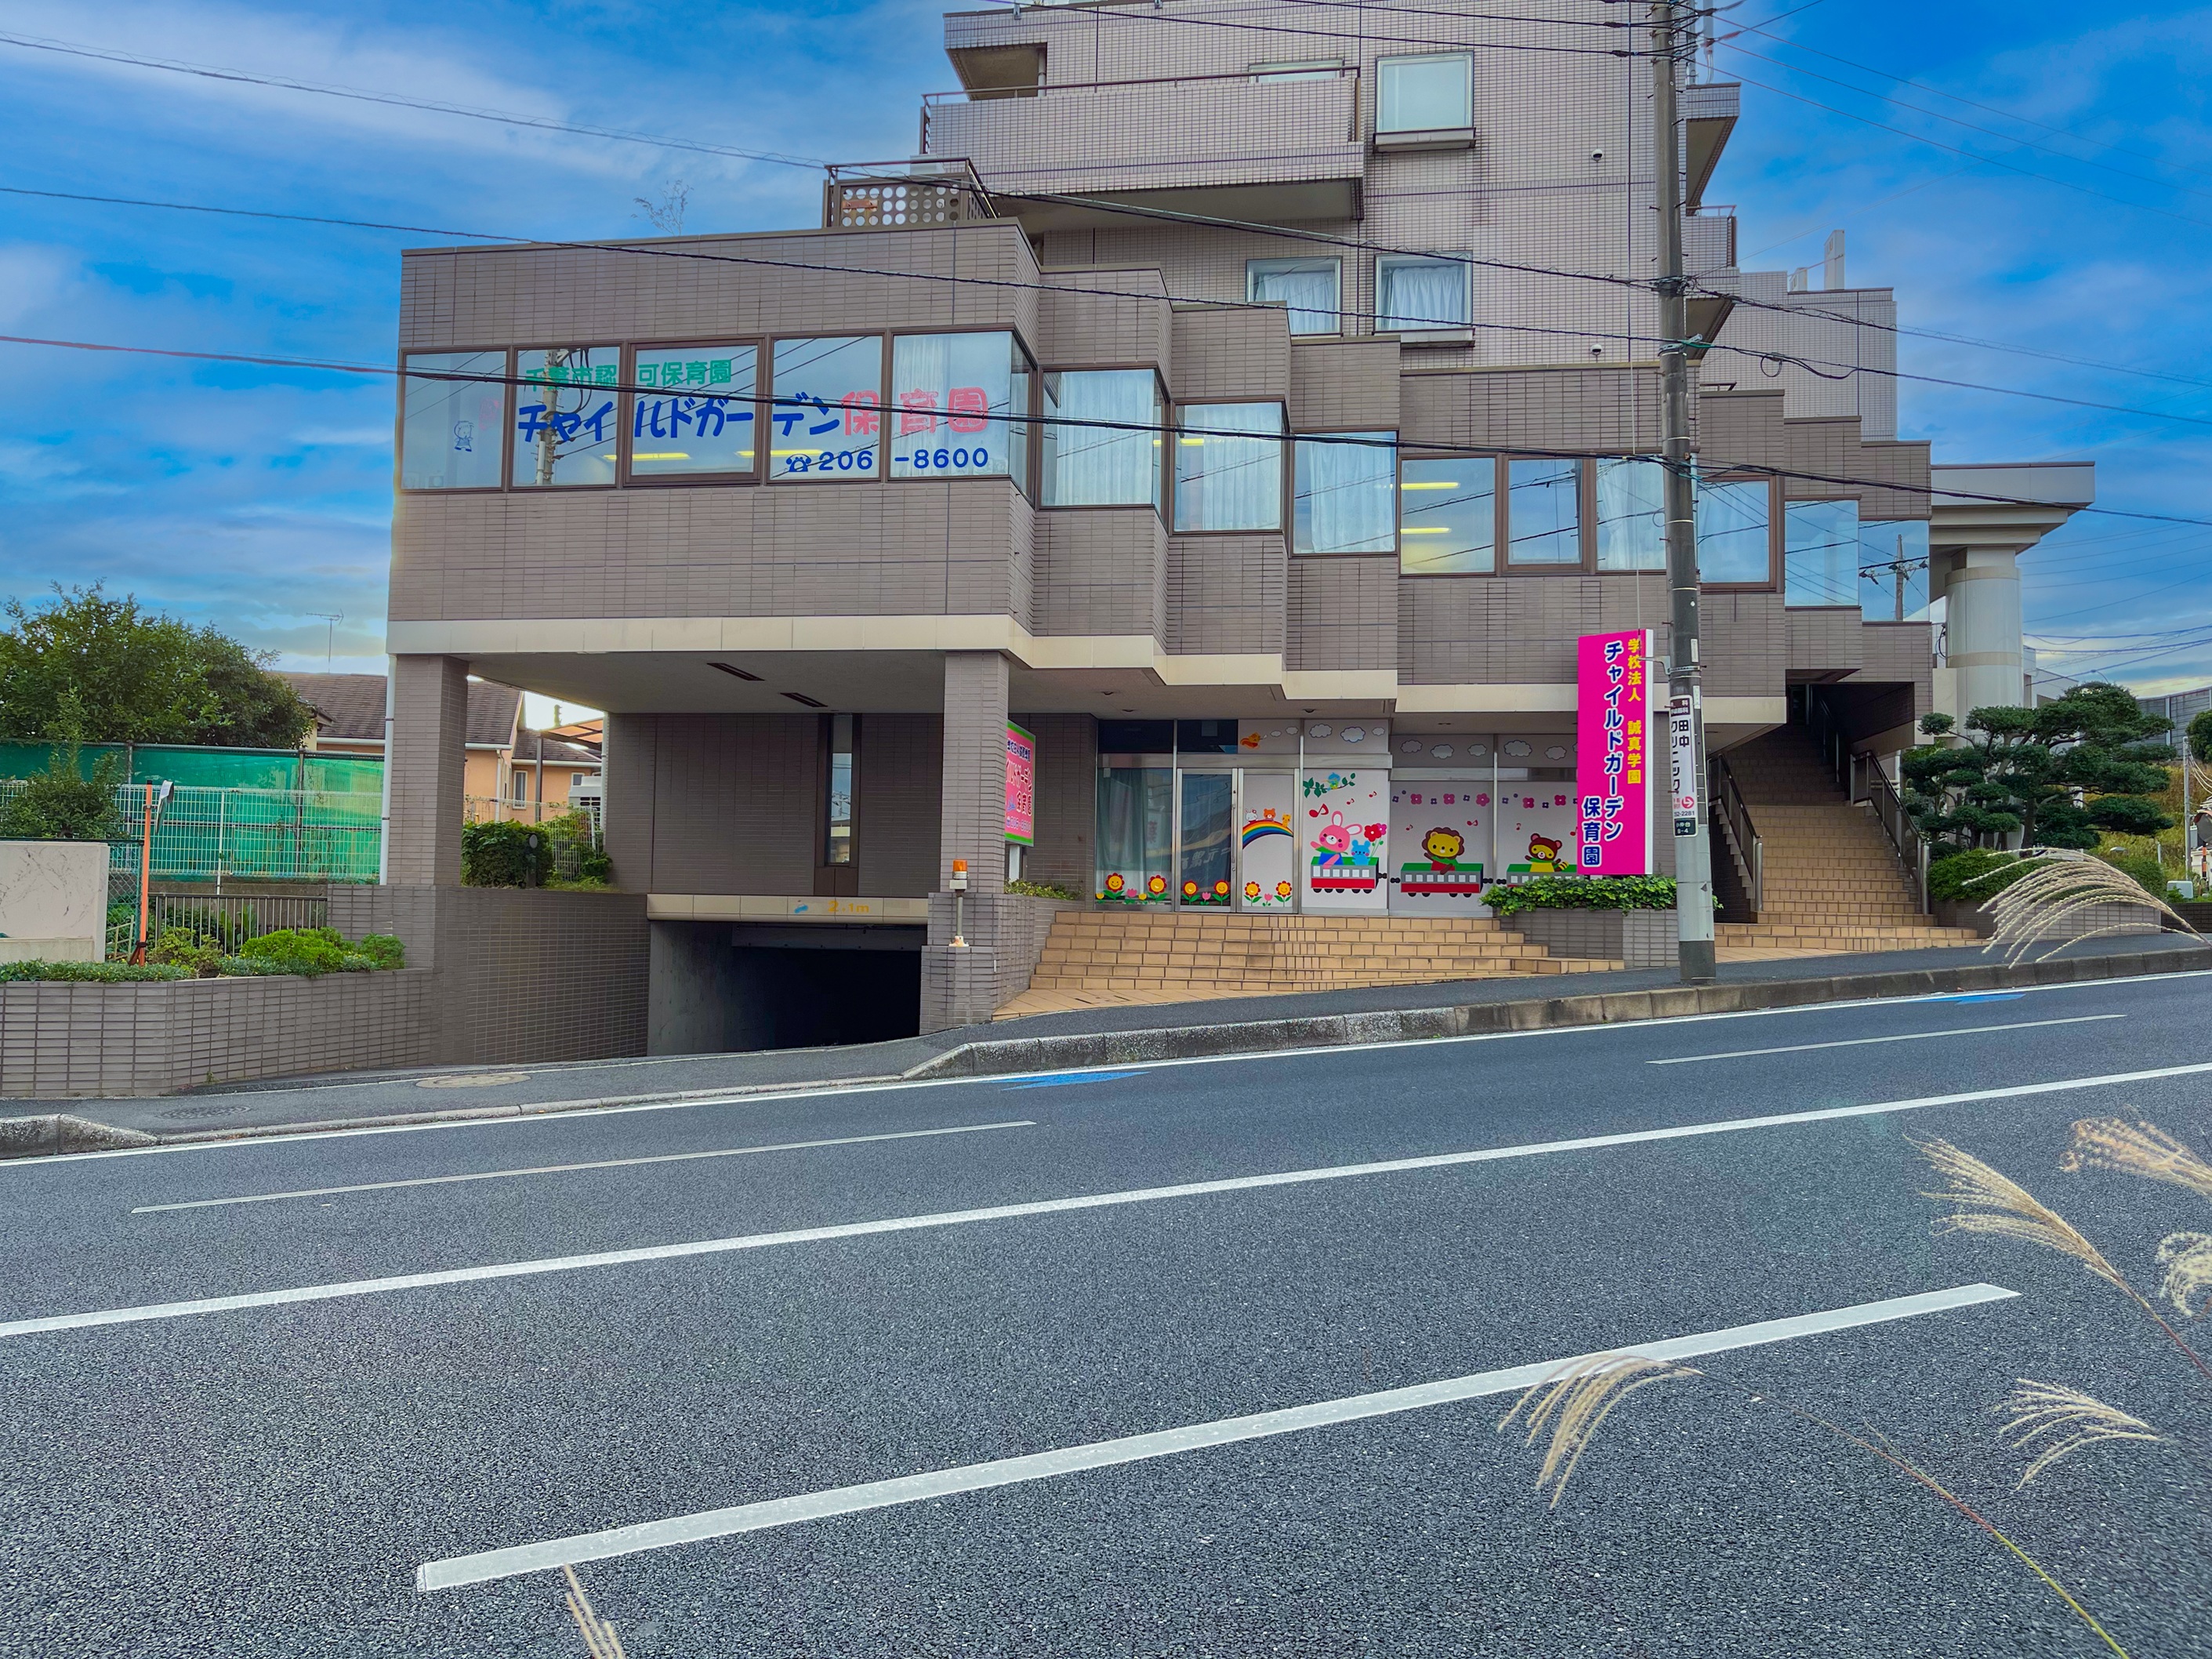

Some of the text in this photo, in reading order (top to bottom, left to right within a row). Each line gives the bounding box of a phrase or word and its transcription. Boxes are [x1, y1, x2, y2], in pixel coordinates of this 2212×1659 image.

[818, 447, 988, 470] 206-8600
[1627, 638, 1642, 702] 学校法人
[1605, 641, 1623, 841] チャイルドガーデン
[1670, 720, 1680, 792] クリニック
[1678, 719, 1689, 748] 田中
[1583, 796, 1601, 867] 保育園
[828, 899, 870, 913] 2.1m
